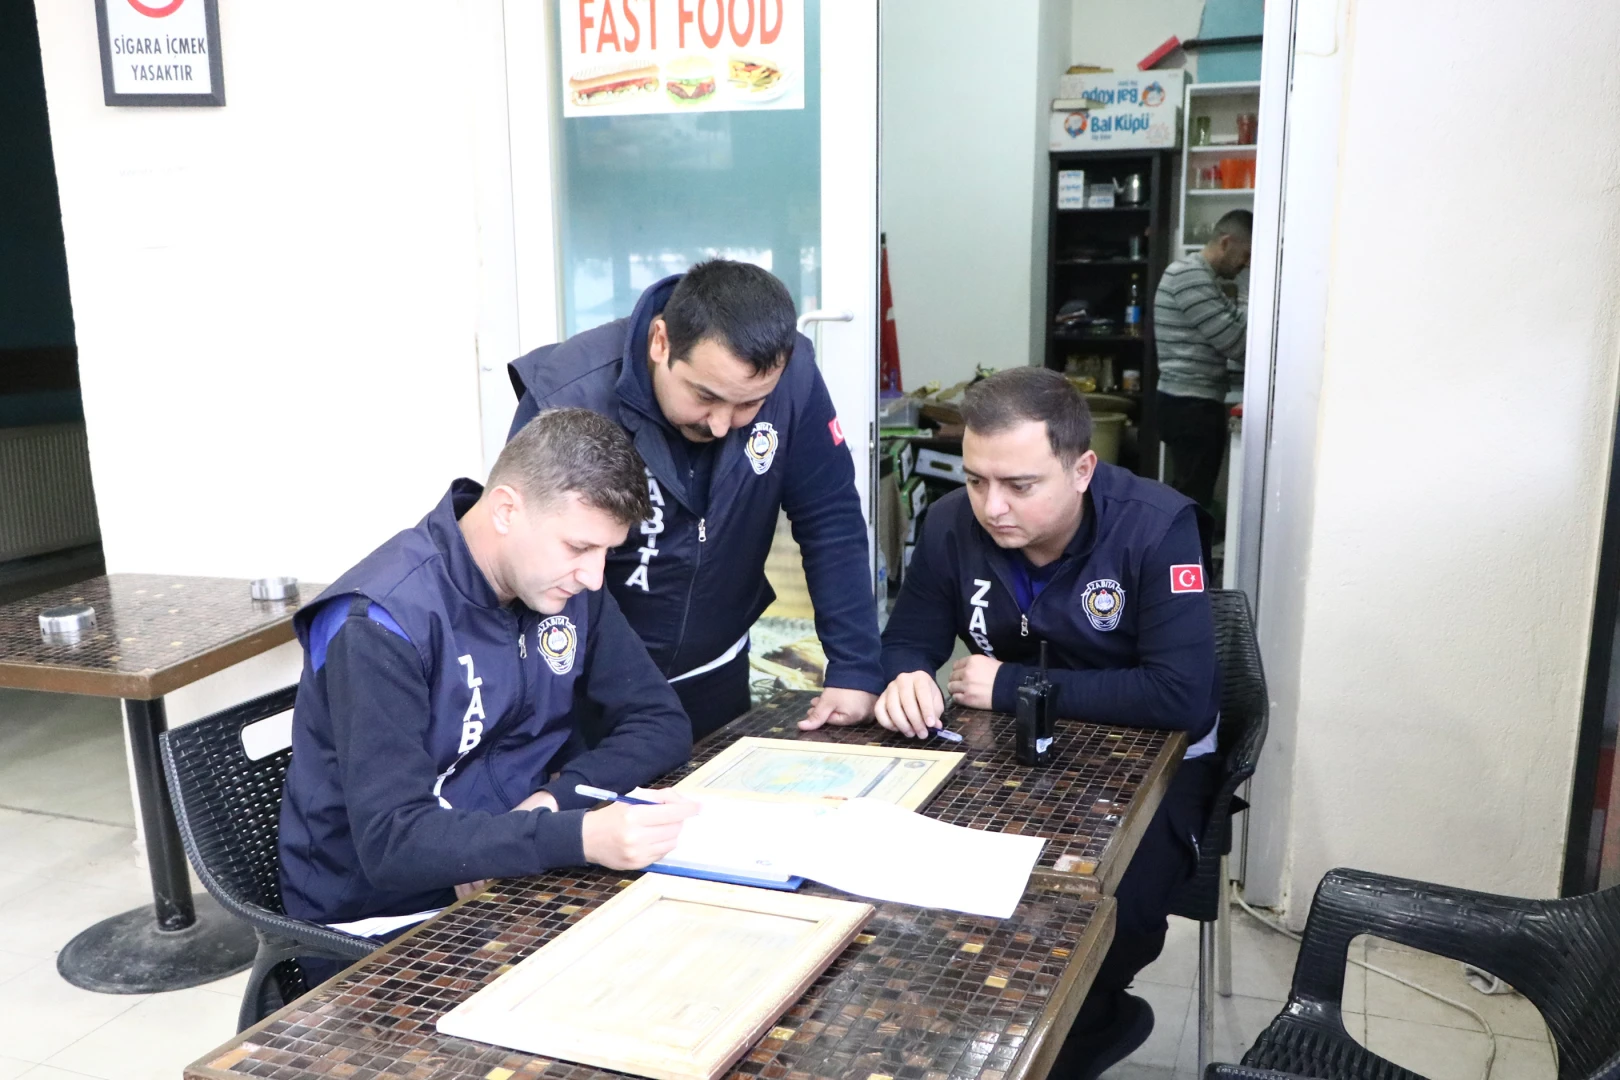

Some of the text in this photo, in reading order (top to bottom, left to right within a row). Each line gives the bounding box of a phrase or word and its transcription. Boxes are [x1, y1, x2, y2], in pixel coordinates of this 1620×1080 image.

[578, 0, 783, 53] FAST FOOD
[114, 34, 206, 58] SİGARA İÇMEK
[131, 64, 193, 81] YASAKTIR
[1118, 88, 1138, 103] Bal
[1091, 113, 1149, 134] Bal Küpü
[625, 466, 665, 592] ABITA
